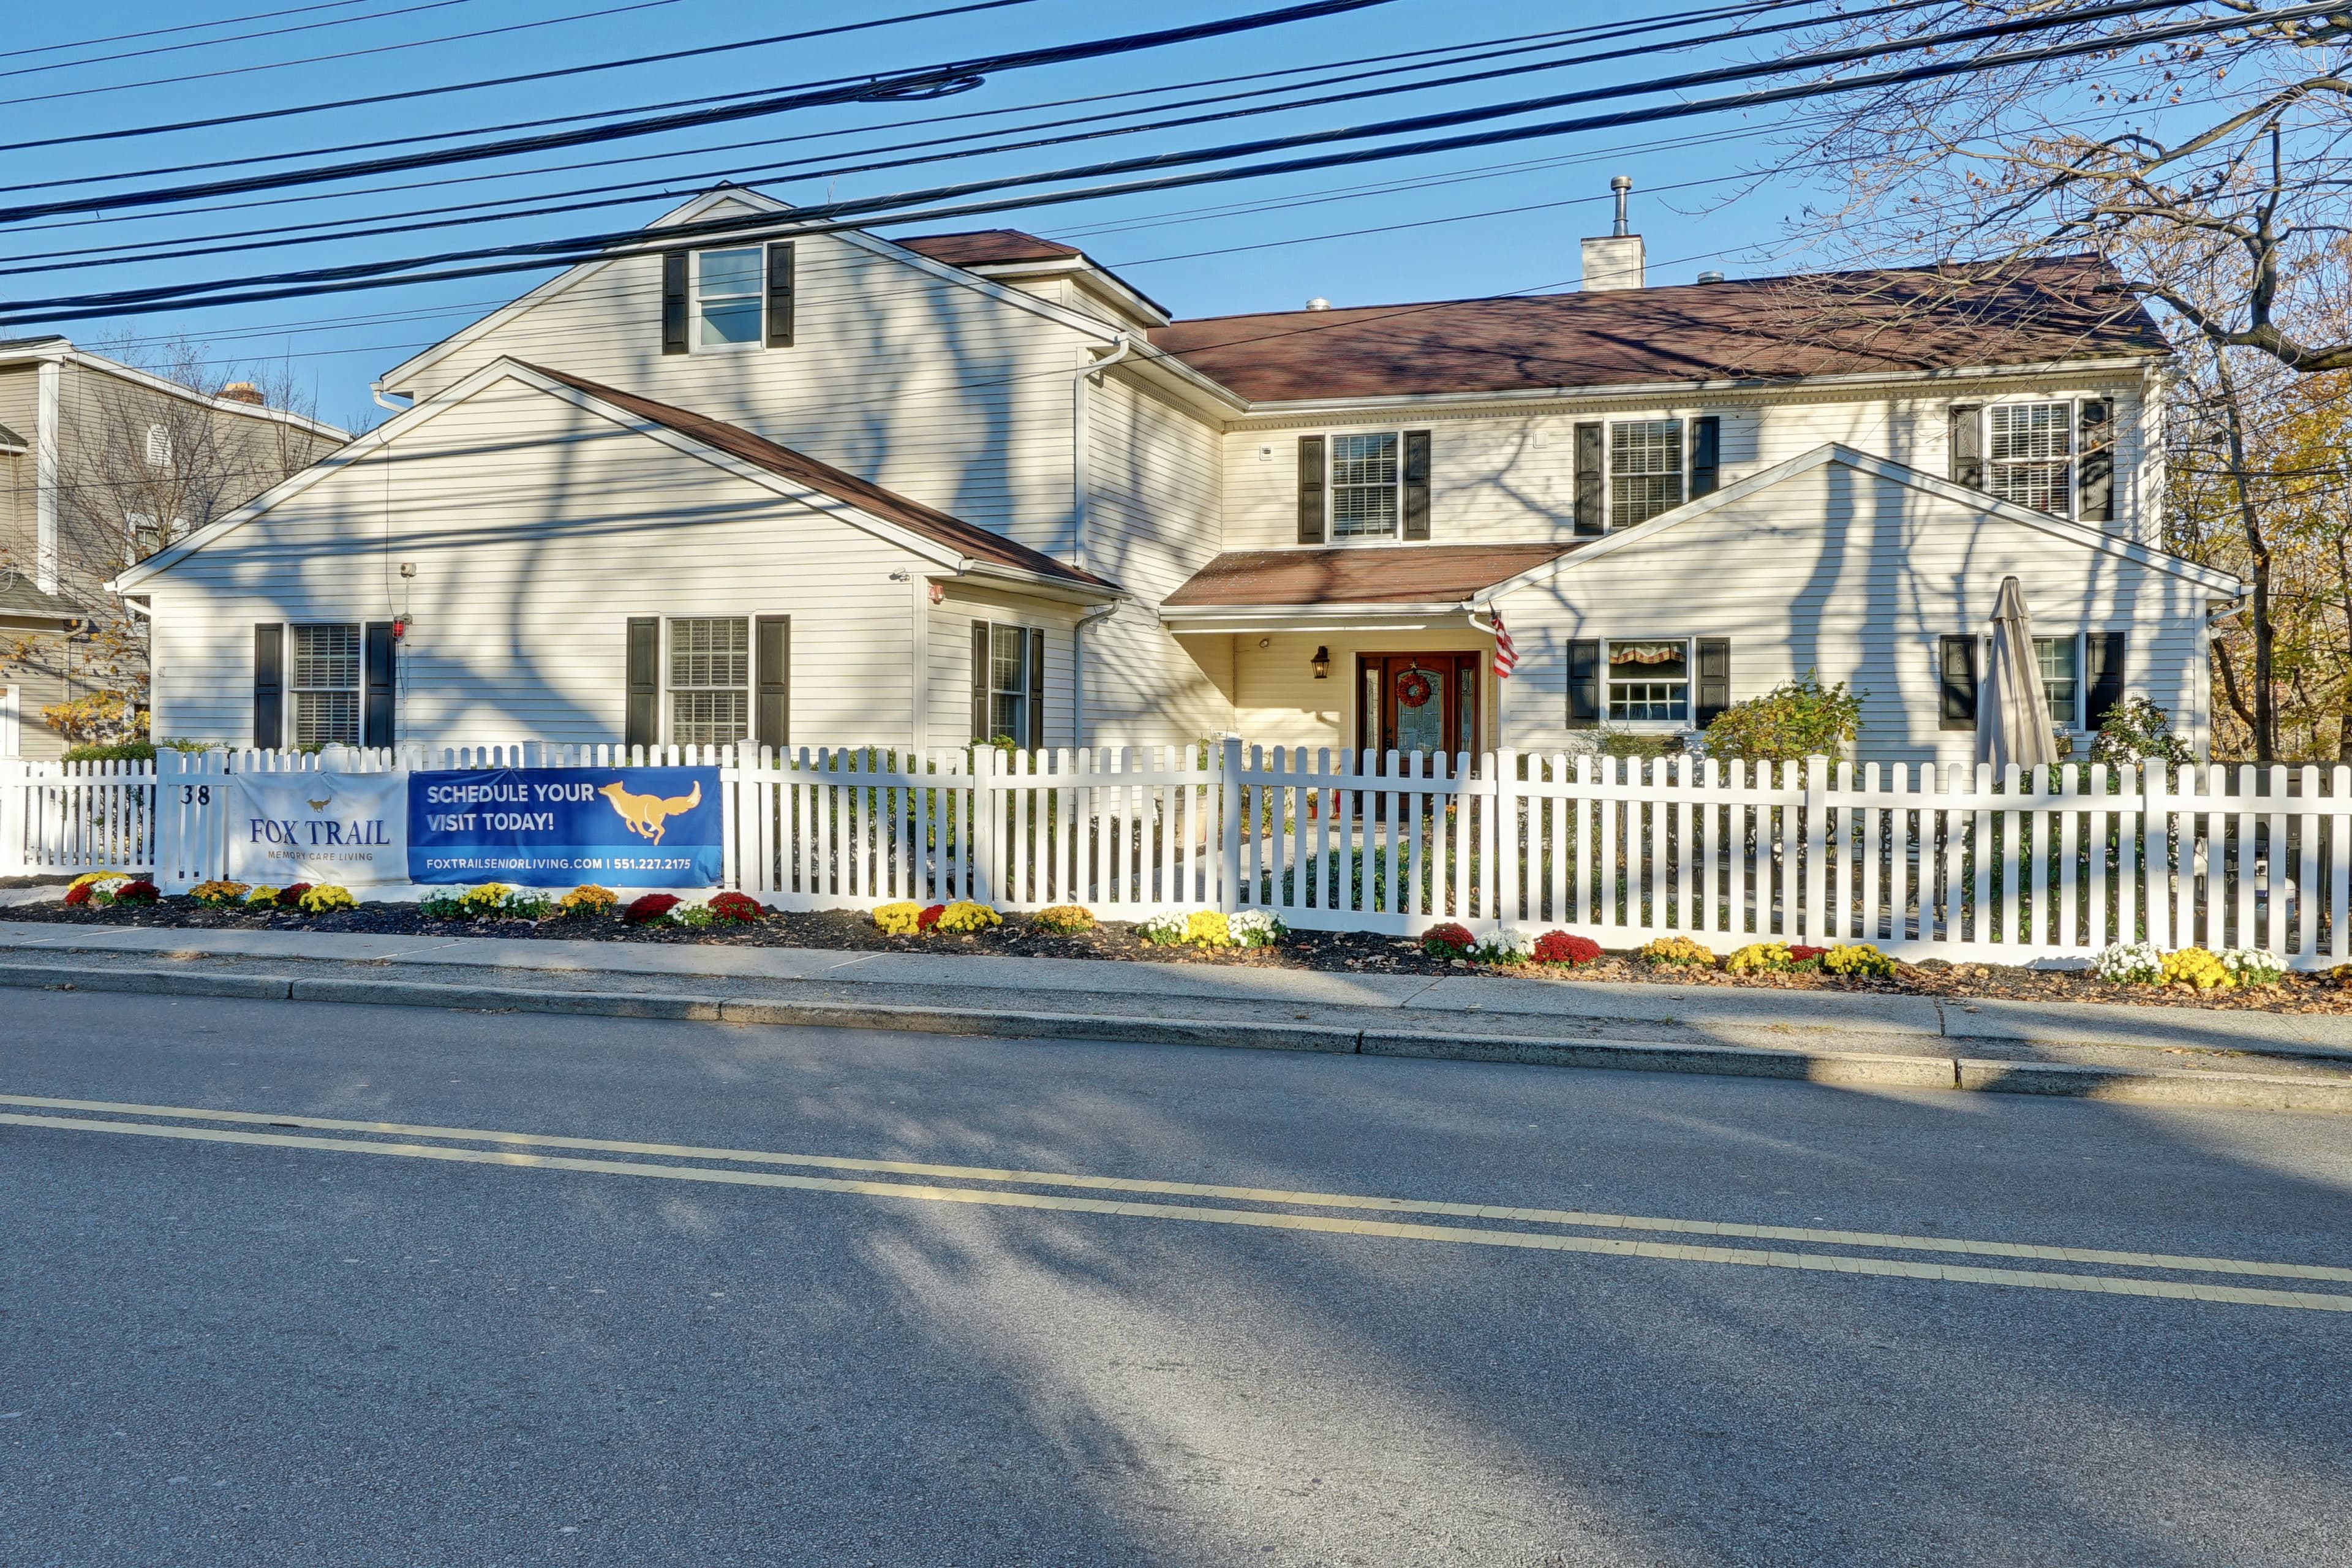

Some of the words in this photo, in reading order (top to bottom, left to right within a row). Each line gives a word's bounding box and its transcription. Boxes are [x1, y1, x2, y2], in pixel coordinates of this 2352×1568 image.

[180, 785, 210, 805] 38
[428, 785, 528, 803] SCHEDULE
[534, 783, 595, 802] YOUR
[427, 814, 477, 831] VISIT
[482, 813, 554, 831] TODAY!
[250, 819, 299, 845] FOX
[304, 820, 391, 846] TRAIL
[268, 851, 306, 860] MEMORY
[339, 853, 373, 861] LIVING
[426, 859, 602, 869] FOXTRAILSENIORLIVING.COM
[614, 859, 691, 869] 551.227.2175
